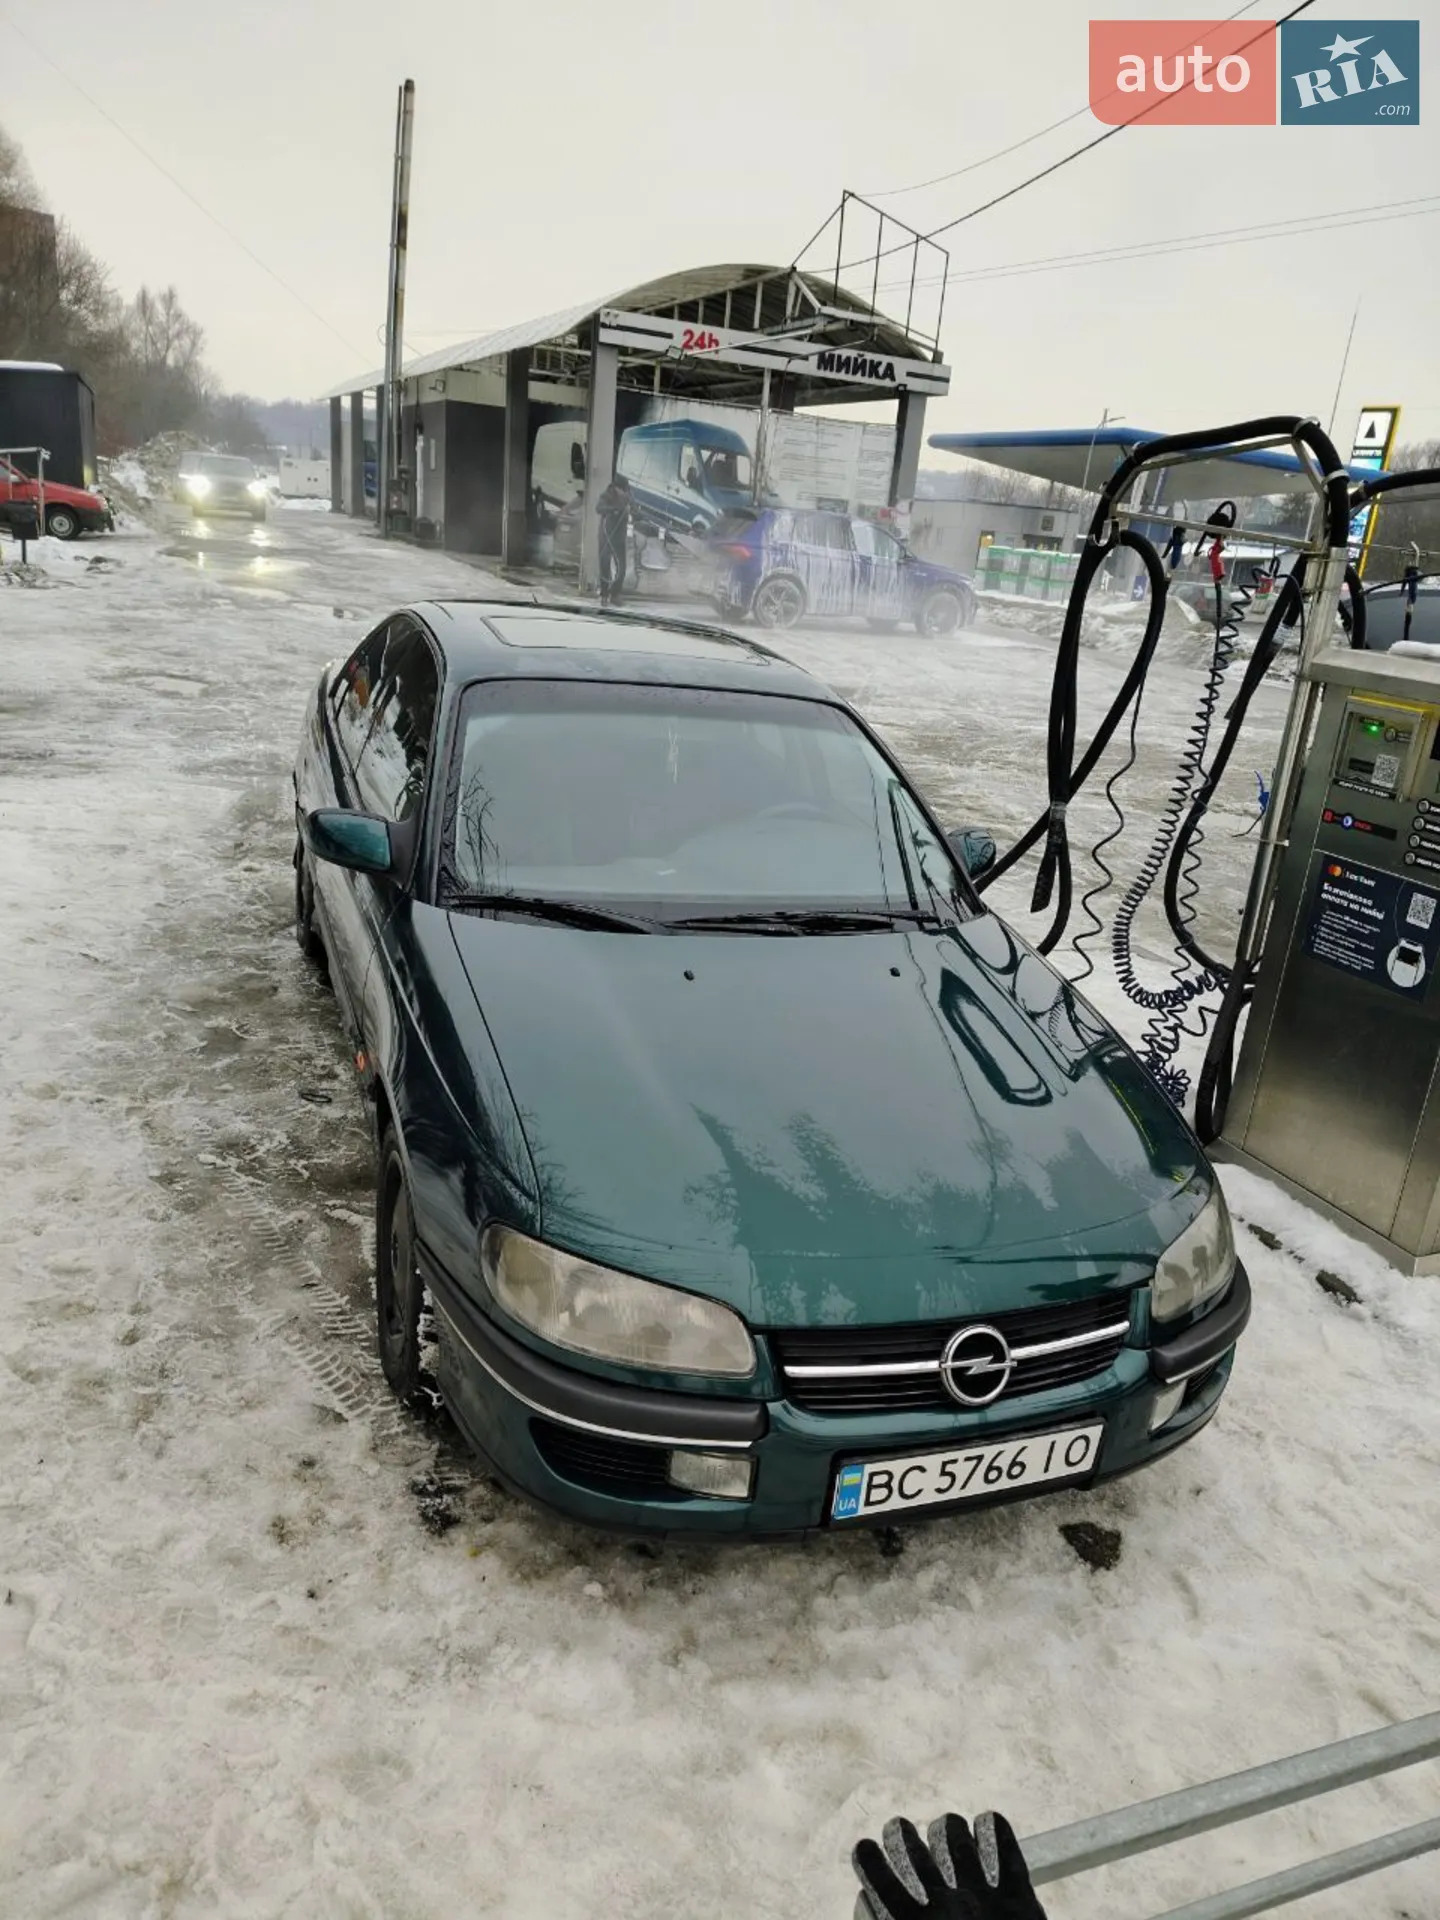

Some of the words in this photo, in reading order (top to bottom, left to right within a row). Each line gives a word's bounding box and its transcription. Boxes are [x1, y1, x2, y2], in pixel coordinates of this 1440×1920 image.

[682, 328, 720, 354] 24h
[817, 352, 896, 382] МИЙКА
[863, 1465, 928, 1507] BC
[934, 1445, 1029, 1494] 5766
[1043, 1434, 1091, 1474] IO
[838, 1498, 857, 1512] UA
